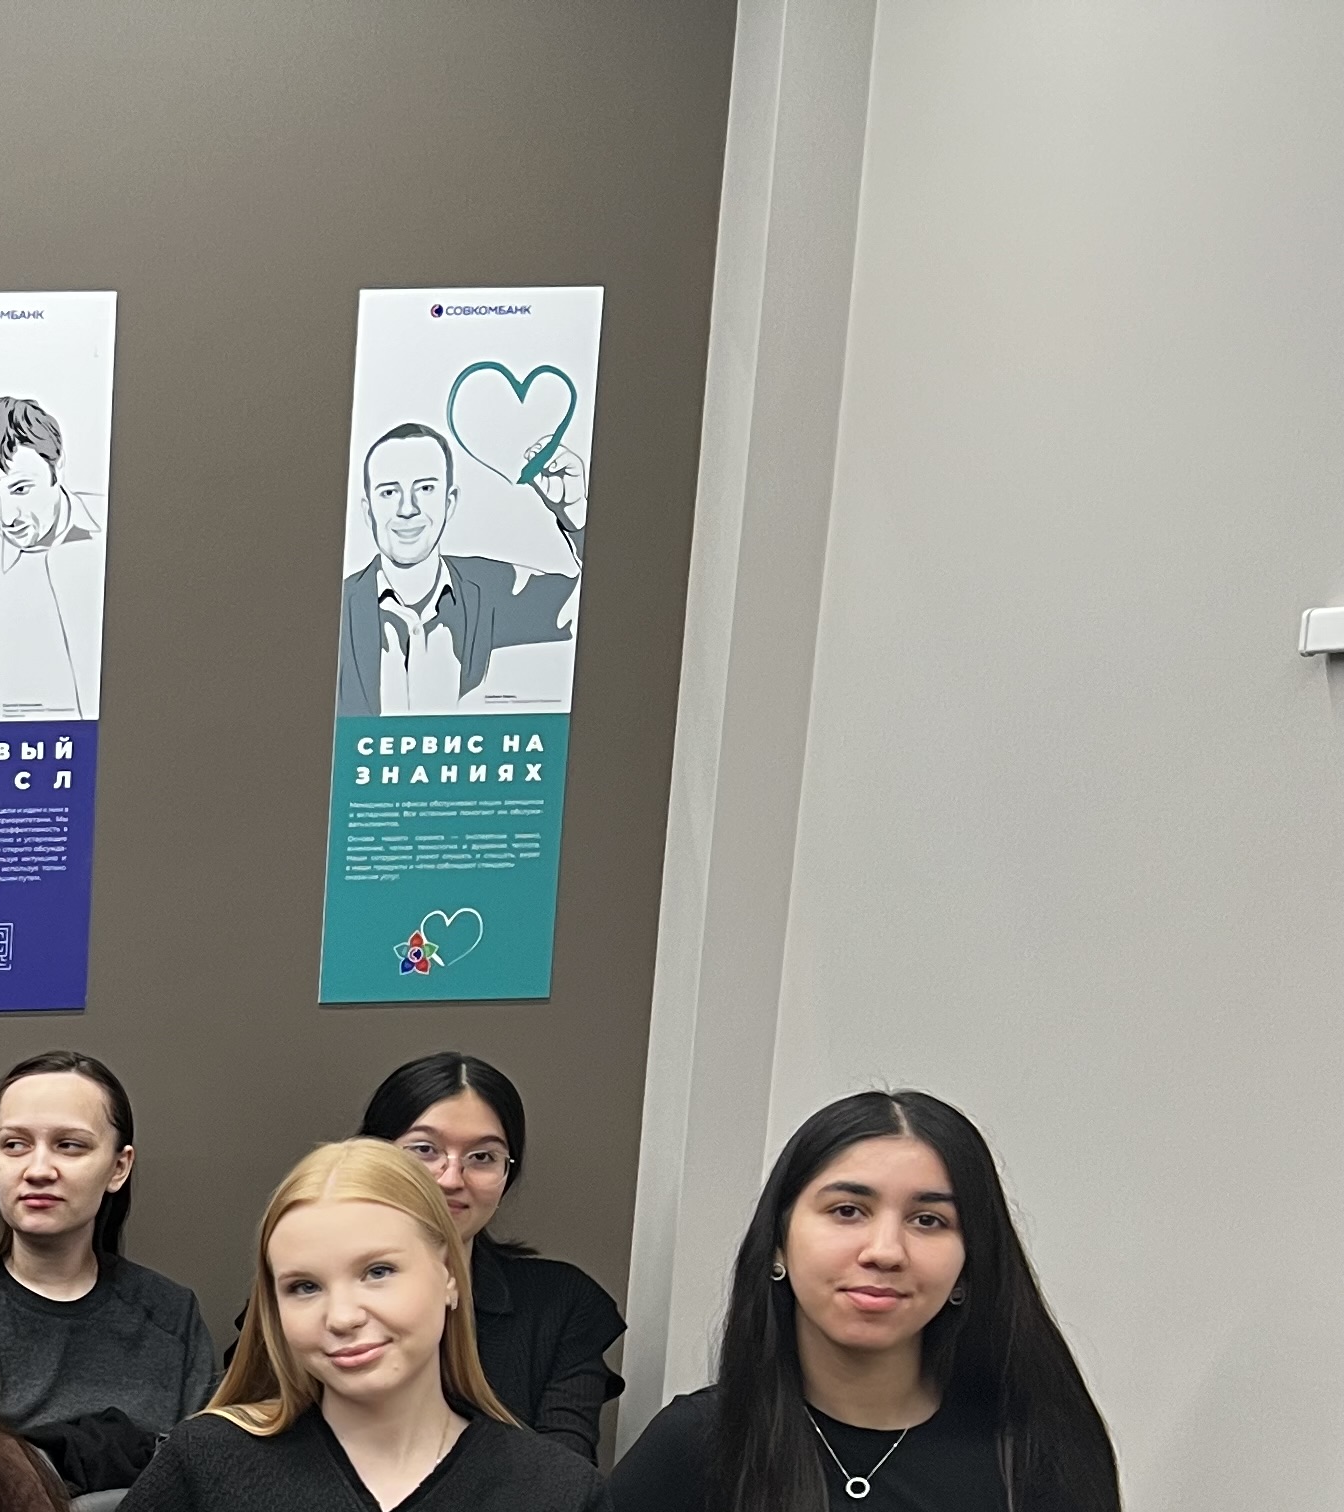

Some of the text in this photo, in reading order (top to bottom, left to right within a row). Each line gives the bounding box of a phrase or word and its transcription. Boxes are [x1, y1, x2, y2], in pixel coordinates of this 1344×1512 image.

[445, 305, 531, 316] СОВКОМБАНК
[357, 734, 544, 756] СЕРВИС НА
[355, 763, 542, 785] ЗНАНИЯХ
